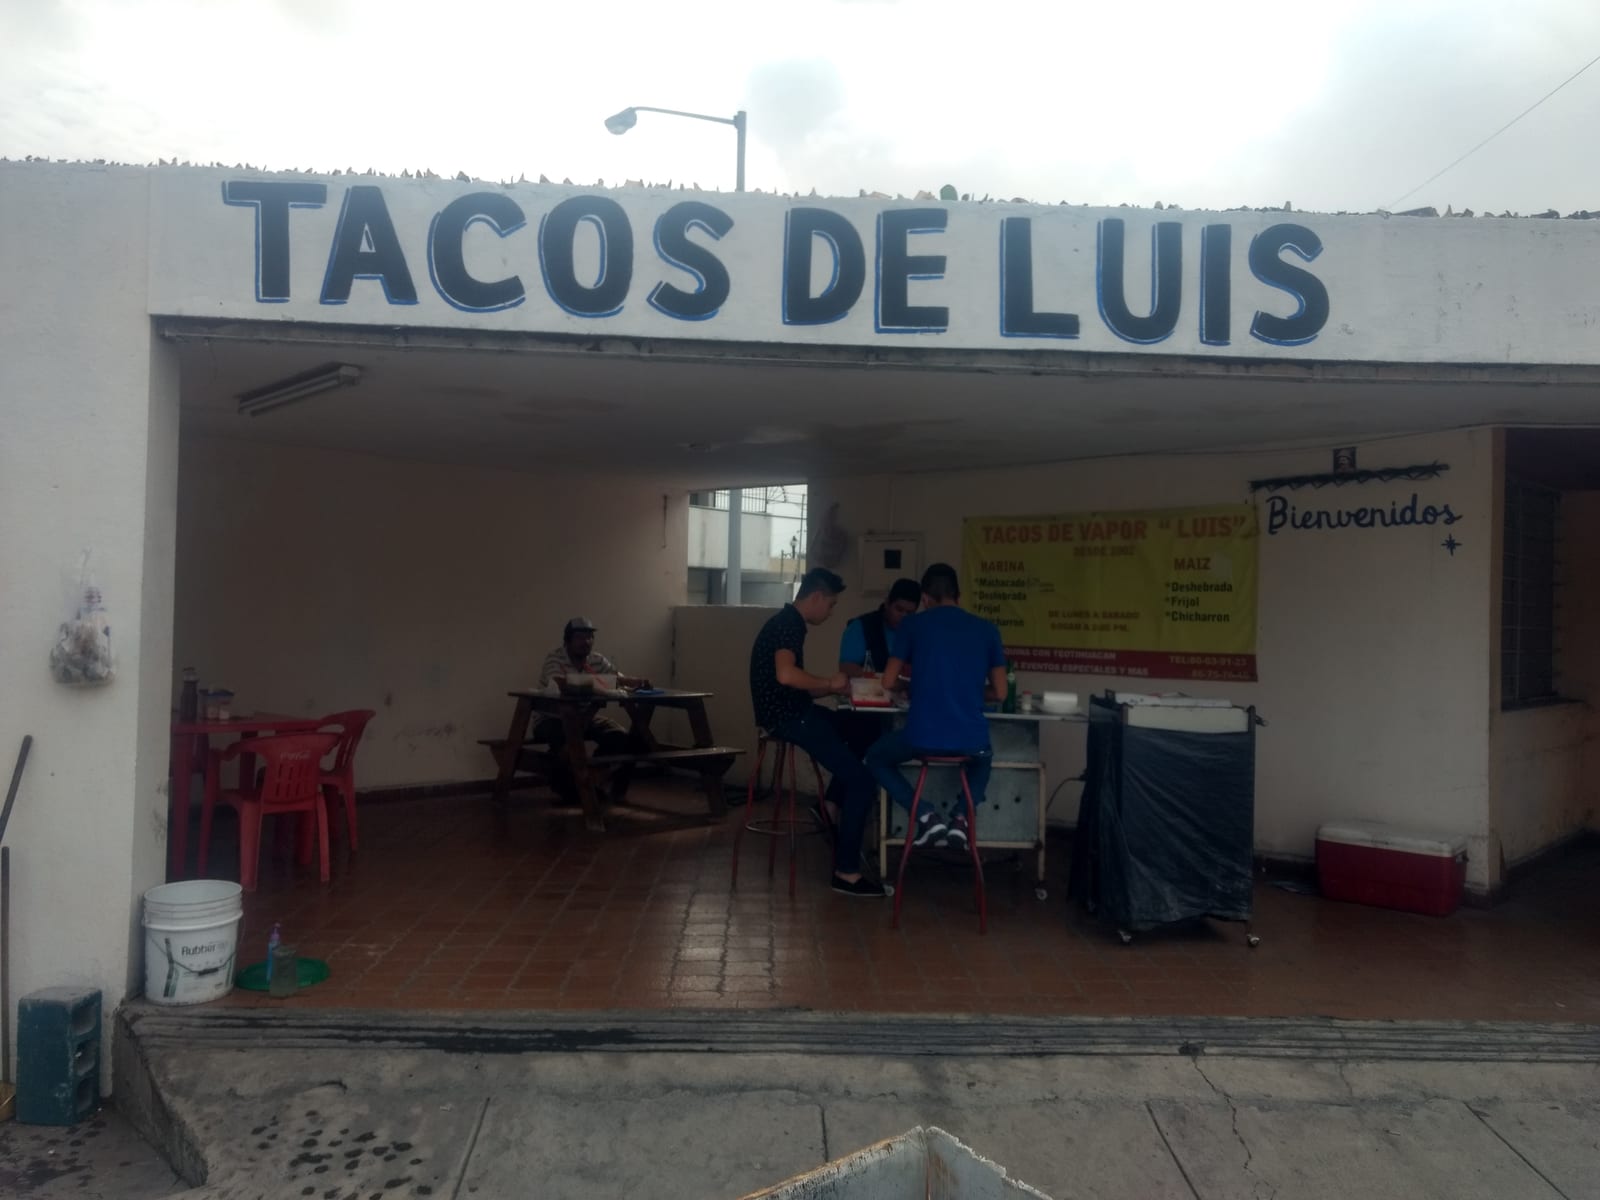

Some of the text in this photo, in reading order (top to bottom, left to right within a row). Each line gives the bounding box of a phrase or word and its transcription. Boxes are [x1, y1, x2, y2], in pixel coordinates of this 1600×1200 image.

[222, 180, 1330, 346] TACOS DE LUIS
[1266, 493, 1463, 535] Bienvenidos
[982, 524, 1042, 544] TACOS
[1047, 523, 1074, 542] DE
[1079, 519, 1147, 541] VAPOR
[981, 560, 1025, 573] HARINA
[1174, 557, 1211, 570] MAIZ
